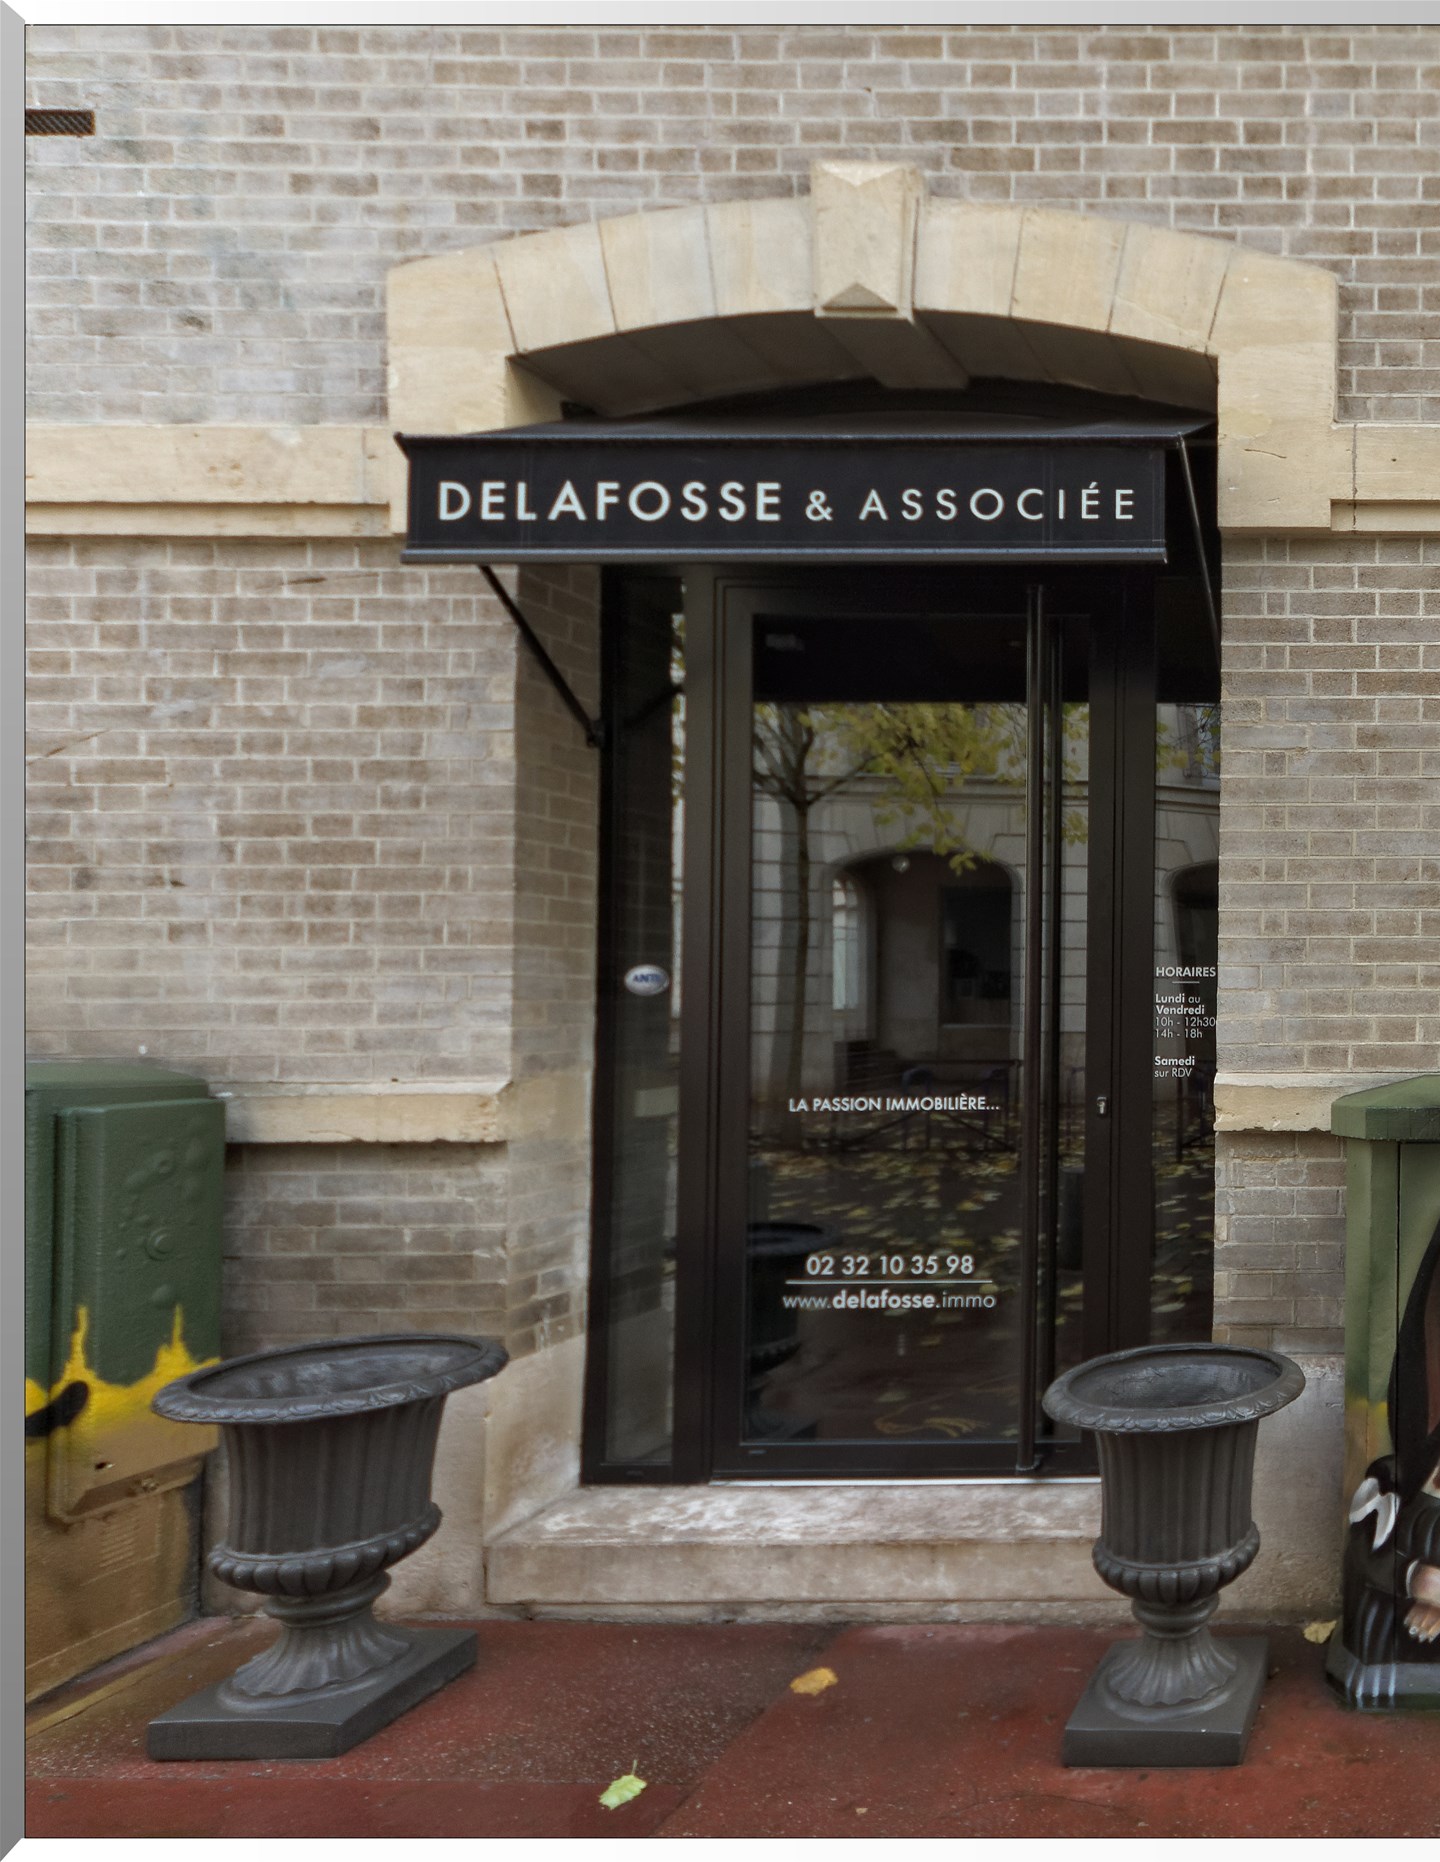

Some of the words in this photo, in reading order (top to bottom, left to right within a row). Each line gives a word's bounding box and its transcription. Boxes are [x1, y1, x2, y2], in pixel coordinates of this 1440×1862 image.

[439, 480, 782, 523] DELAFOSSE
[805, 490, 833, 522] &
[859, 482, 1135, 521] ASSOCIÉE
[1155, 966, 1216, 978] HORAIRES
[1155, 993, 1185, 1004] Lundi
[1188, 996, 1201, 1004] au
[1156, 1004, 1205, 1015] Vendredi
[1155, 1016, 1174, 1027] 10h
[1185, 1016, 1216, 1027] 12h30
[1155, 1028, 1173, 1039] 14h
[1185, 1028, 1203, 1039] 18h
[1154, 1055, 1195, 1066] Samedi
[1154, 1070, 1169, 1078] sur
[1171, 1067, 1193, 1078] RDV
[789, 1098, 809, 1113] LA
[813, 1097, 882, 1112] PASSION
[886, 1093, 1000, 1111] IMMOBILIÈRE...
[806, 1255, 834, 1276] 02
[842, 1255, 869, 1275] 32
[880, 1255, 904, 1275] 10
[910, 1255, 938, 1275] 35
[946, 1255, 974, 1275] 98
[783, 1289, 997, 1309] www.delafosse.immo
